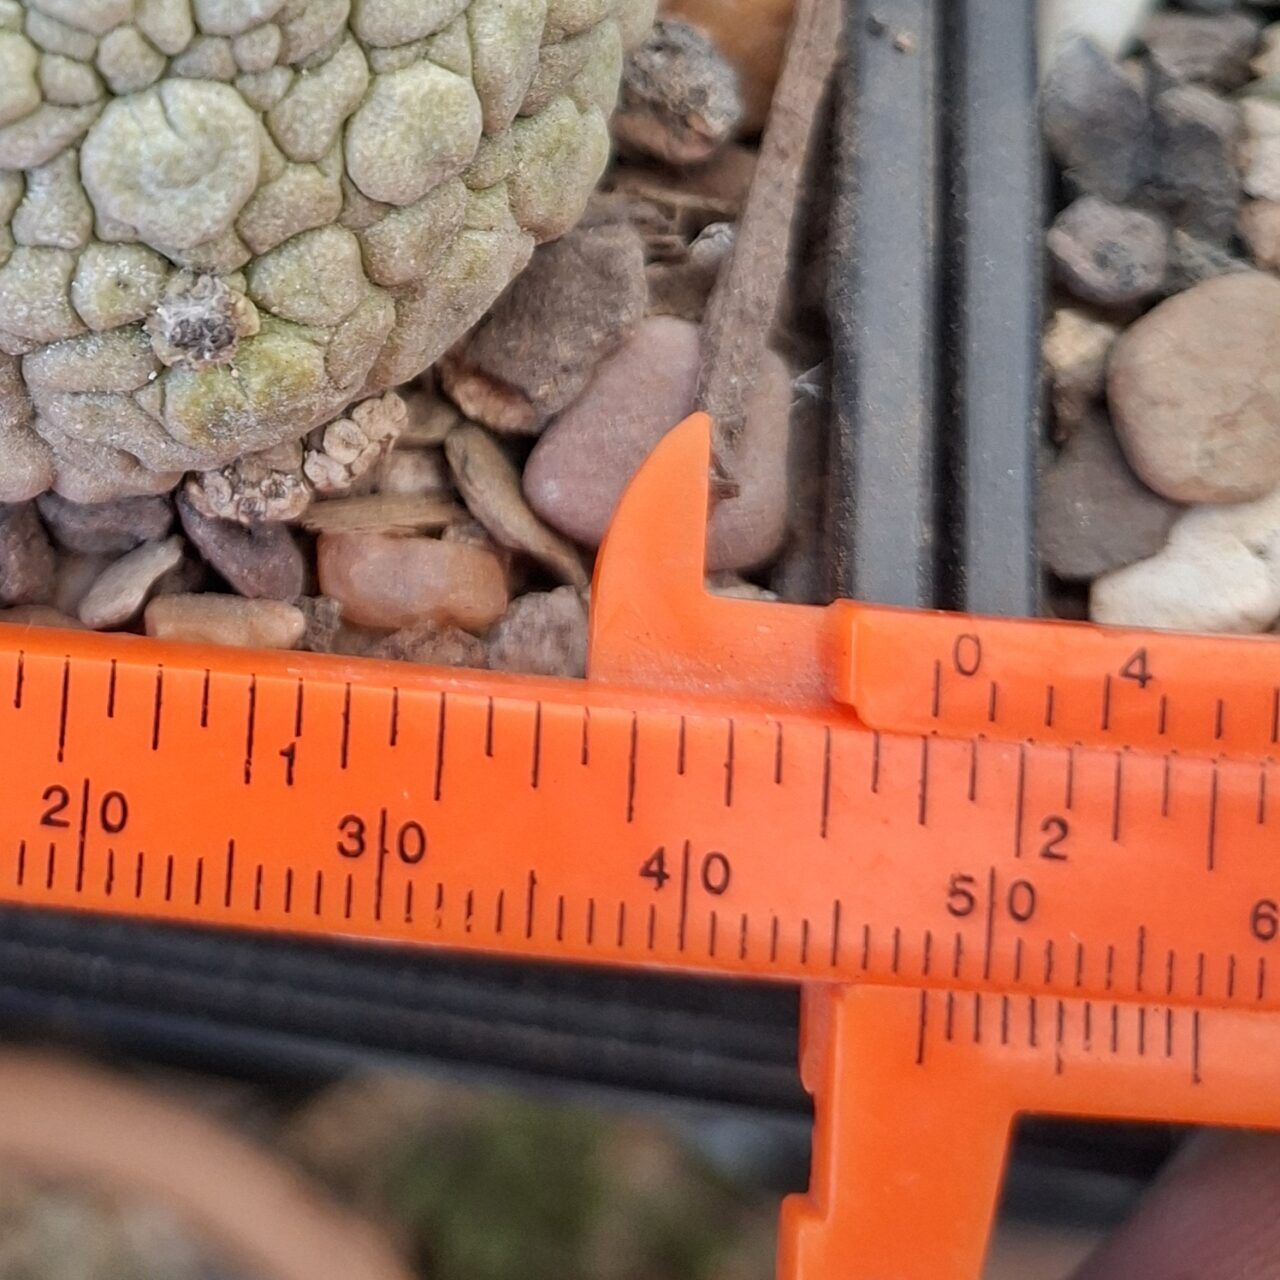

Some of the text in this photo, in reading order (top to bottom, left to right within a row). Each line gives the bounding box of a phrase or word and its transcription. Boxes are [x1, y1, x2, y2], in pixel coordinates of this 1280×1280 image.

[953, 633, 1153, 688] 0 4
[278, 742, 296, 786] 1
[1038, 815, 1069, 861] 2
